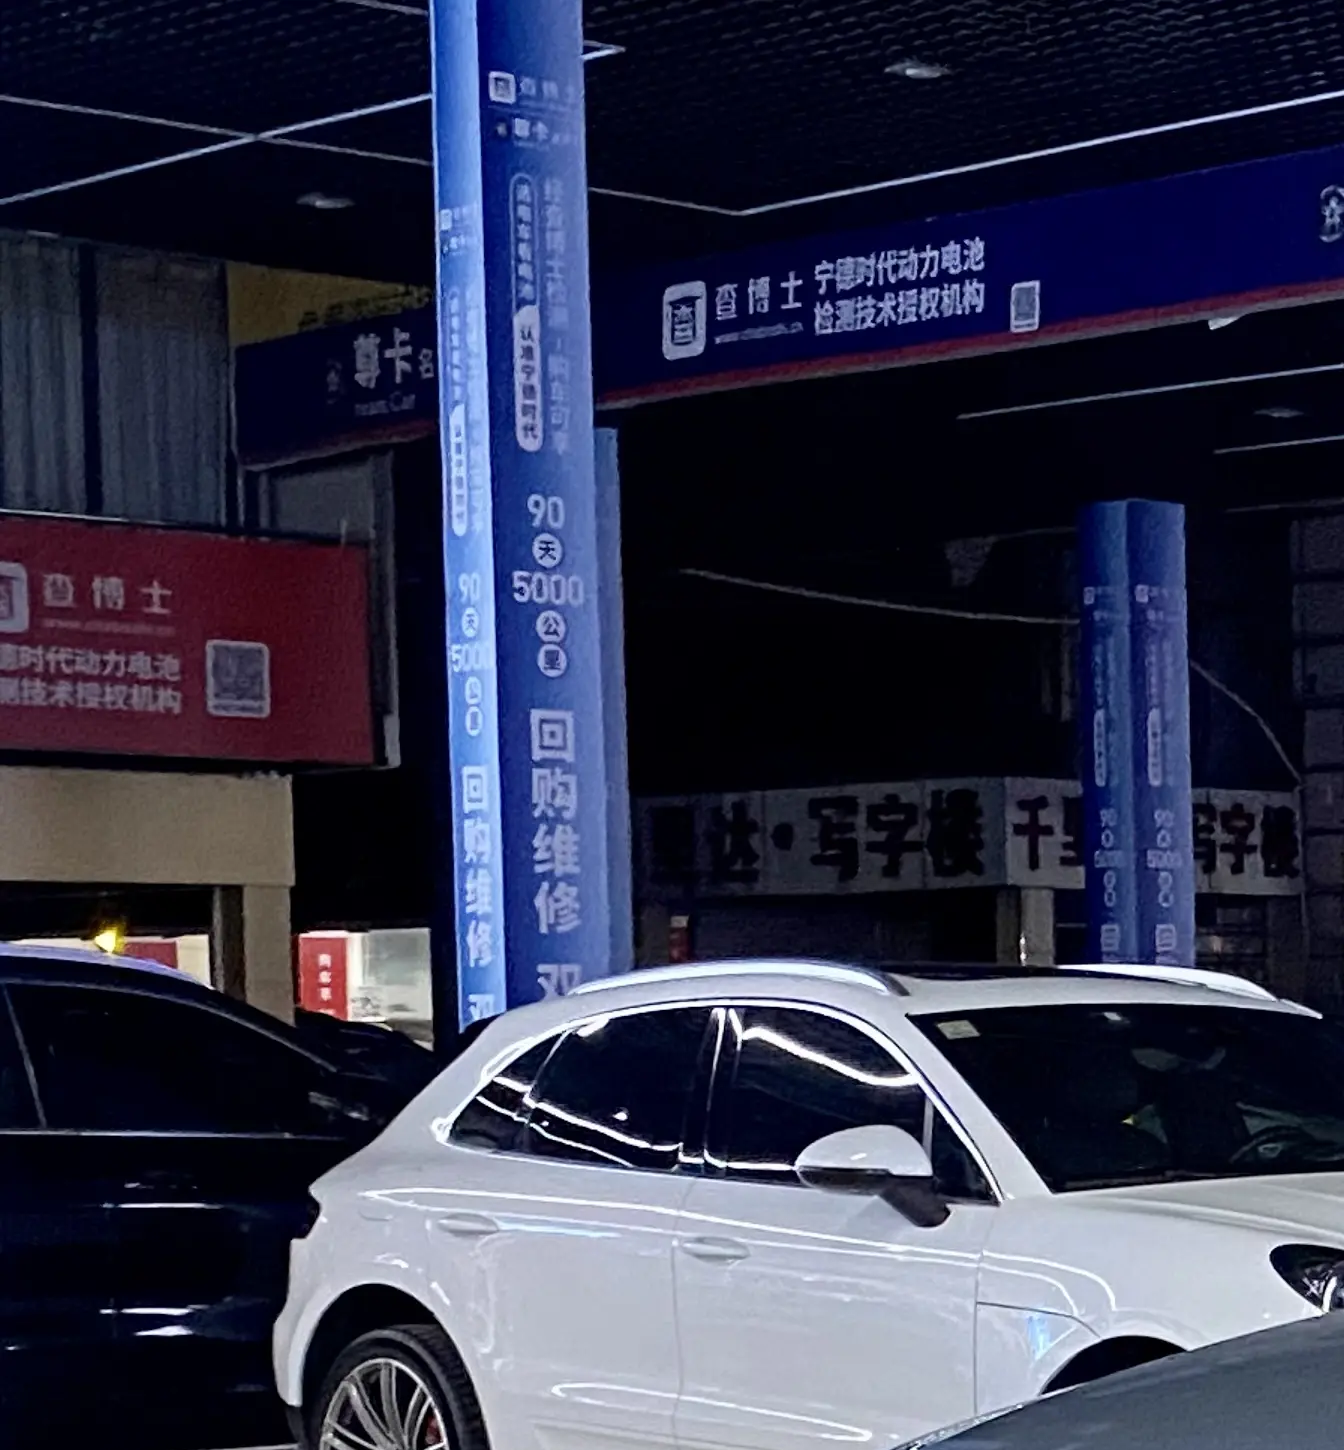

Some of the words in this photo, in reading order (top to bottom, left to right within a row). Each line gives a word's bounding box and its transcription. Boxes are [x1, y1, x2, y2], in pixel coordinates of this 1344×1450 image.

[814, 233, 985, 295] 宁德时代动力电池
[715, 271, 803, 321] 查博士
[814, 278, 985, 336] 检测技术授权机构
[527, 494, 564, 529] 90
[458, 573, 480, 603] 90
[512, 570, 584, 606] 5000
[450, 643, 493, 672] 5000
[529, 708, 582, 934] 回购维修
[461, 765, 493, 968] 回购维修
